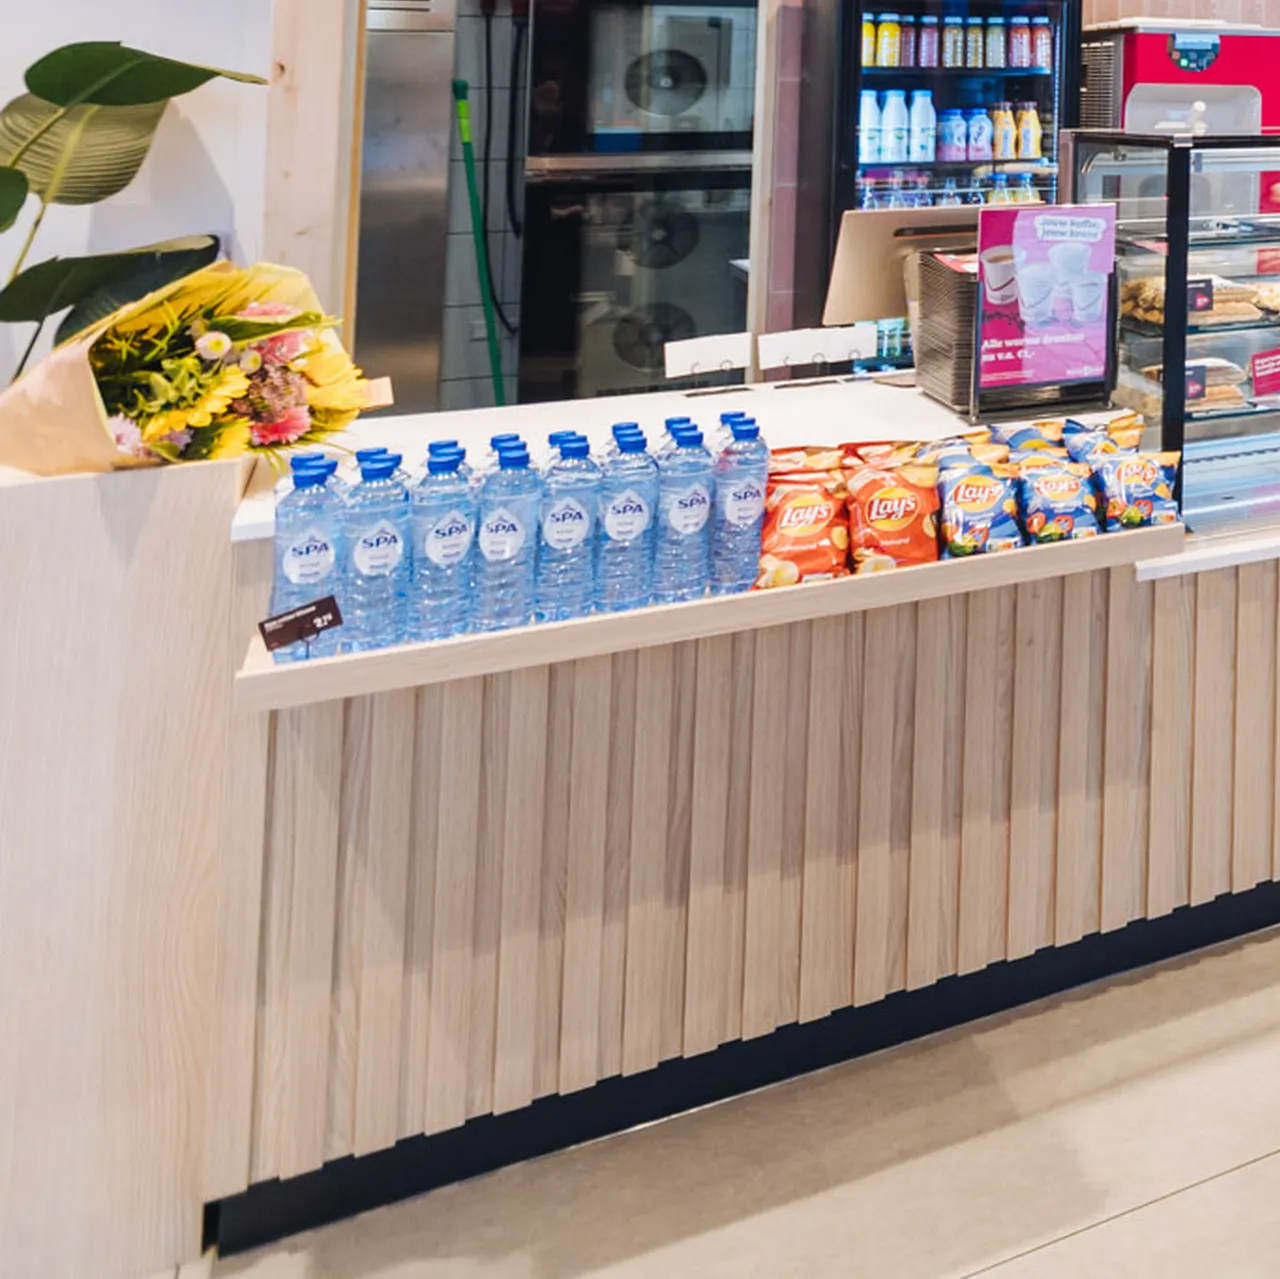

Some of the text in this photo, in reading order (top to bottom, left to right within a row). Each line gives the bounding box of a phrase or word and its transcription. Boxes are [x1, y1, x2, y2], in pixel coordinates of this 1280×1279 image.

[732, 489, 762, 501] SPA
[678, 496, 707, 508] SPA
[611, 503, 644, 515] SPA
[551, 511, 584, 523] SPA
[434, 523, 468, 538] SPA
[485, 522, 518, 535] SPA
[362, 534, 398, 549] SPA
[291, 542, 330, 556] SPA
